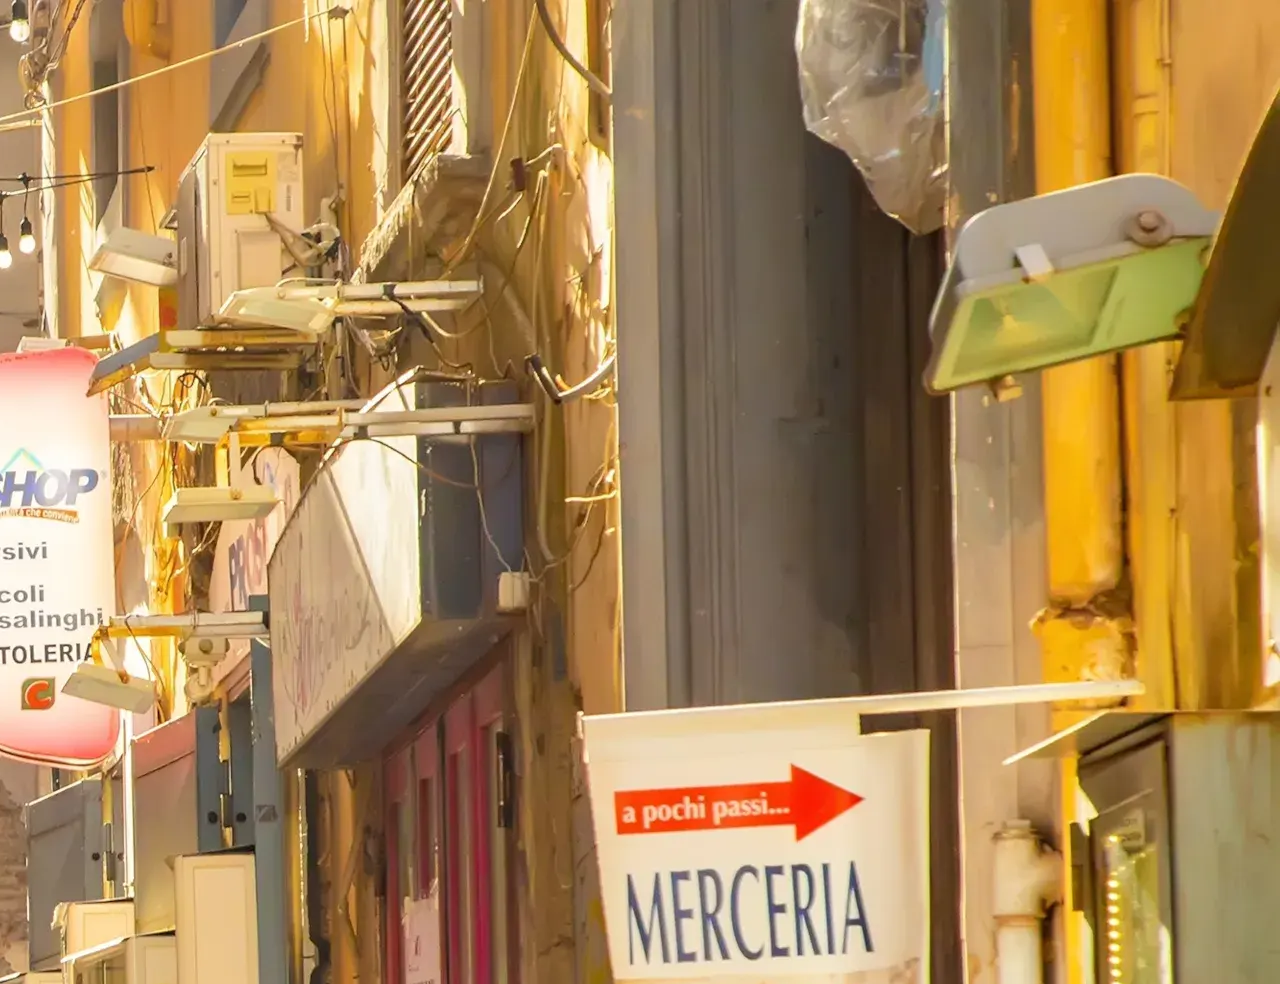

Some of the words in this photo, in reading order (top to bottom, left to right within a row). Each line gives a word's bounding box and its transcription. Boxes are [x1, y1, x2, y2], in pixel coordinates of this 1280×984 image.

[622, 806, 636, 823] a
[644, 795, 705, 828] pochi
[712, 792, 791, 825] passi...
[627, 860, 874, 966] MERCERIA
